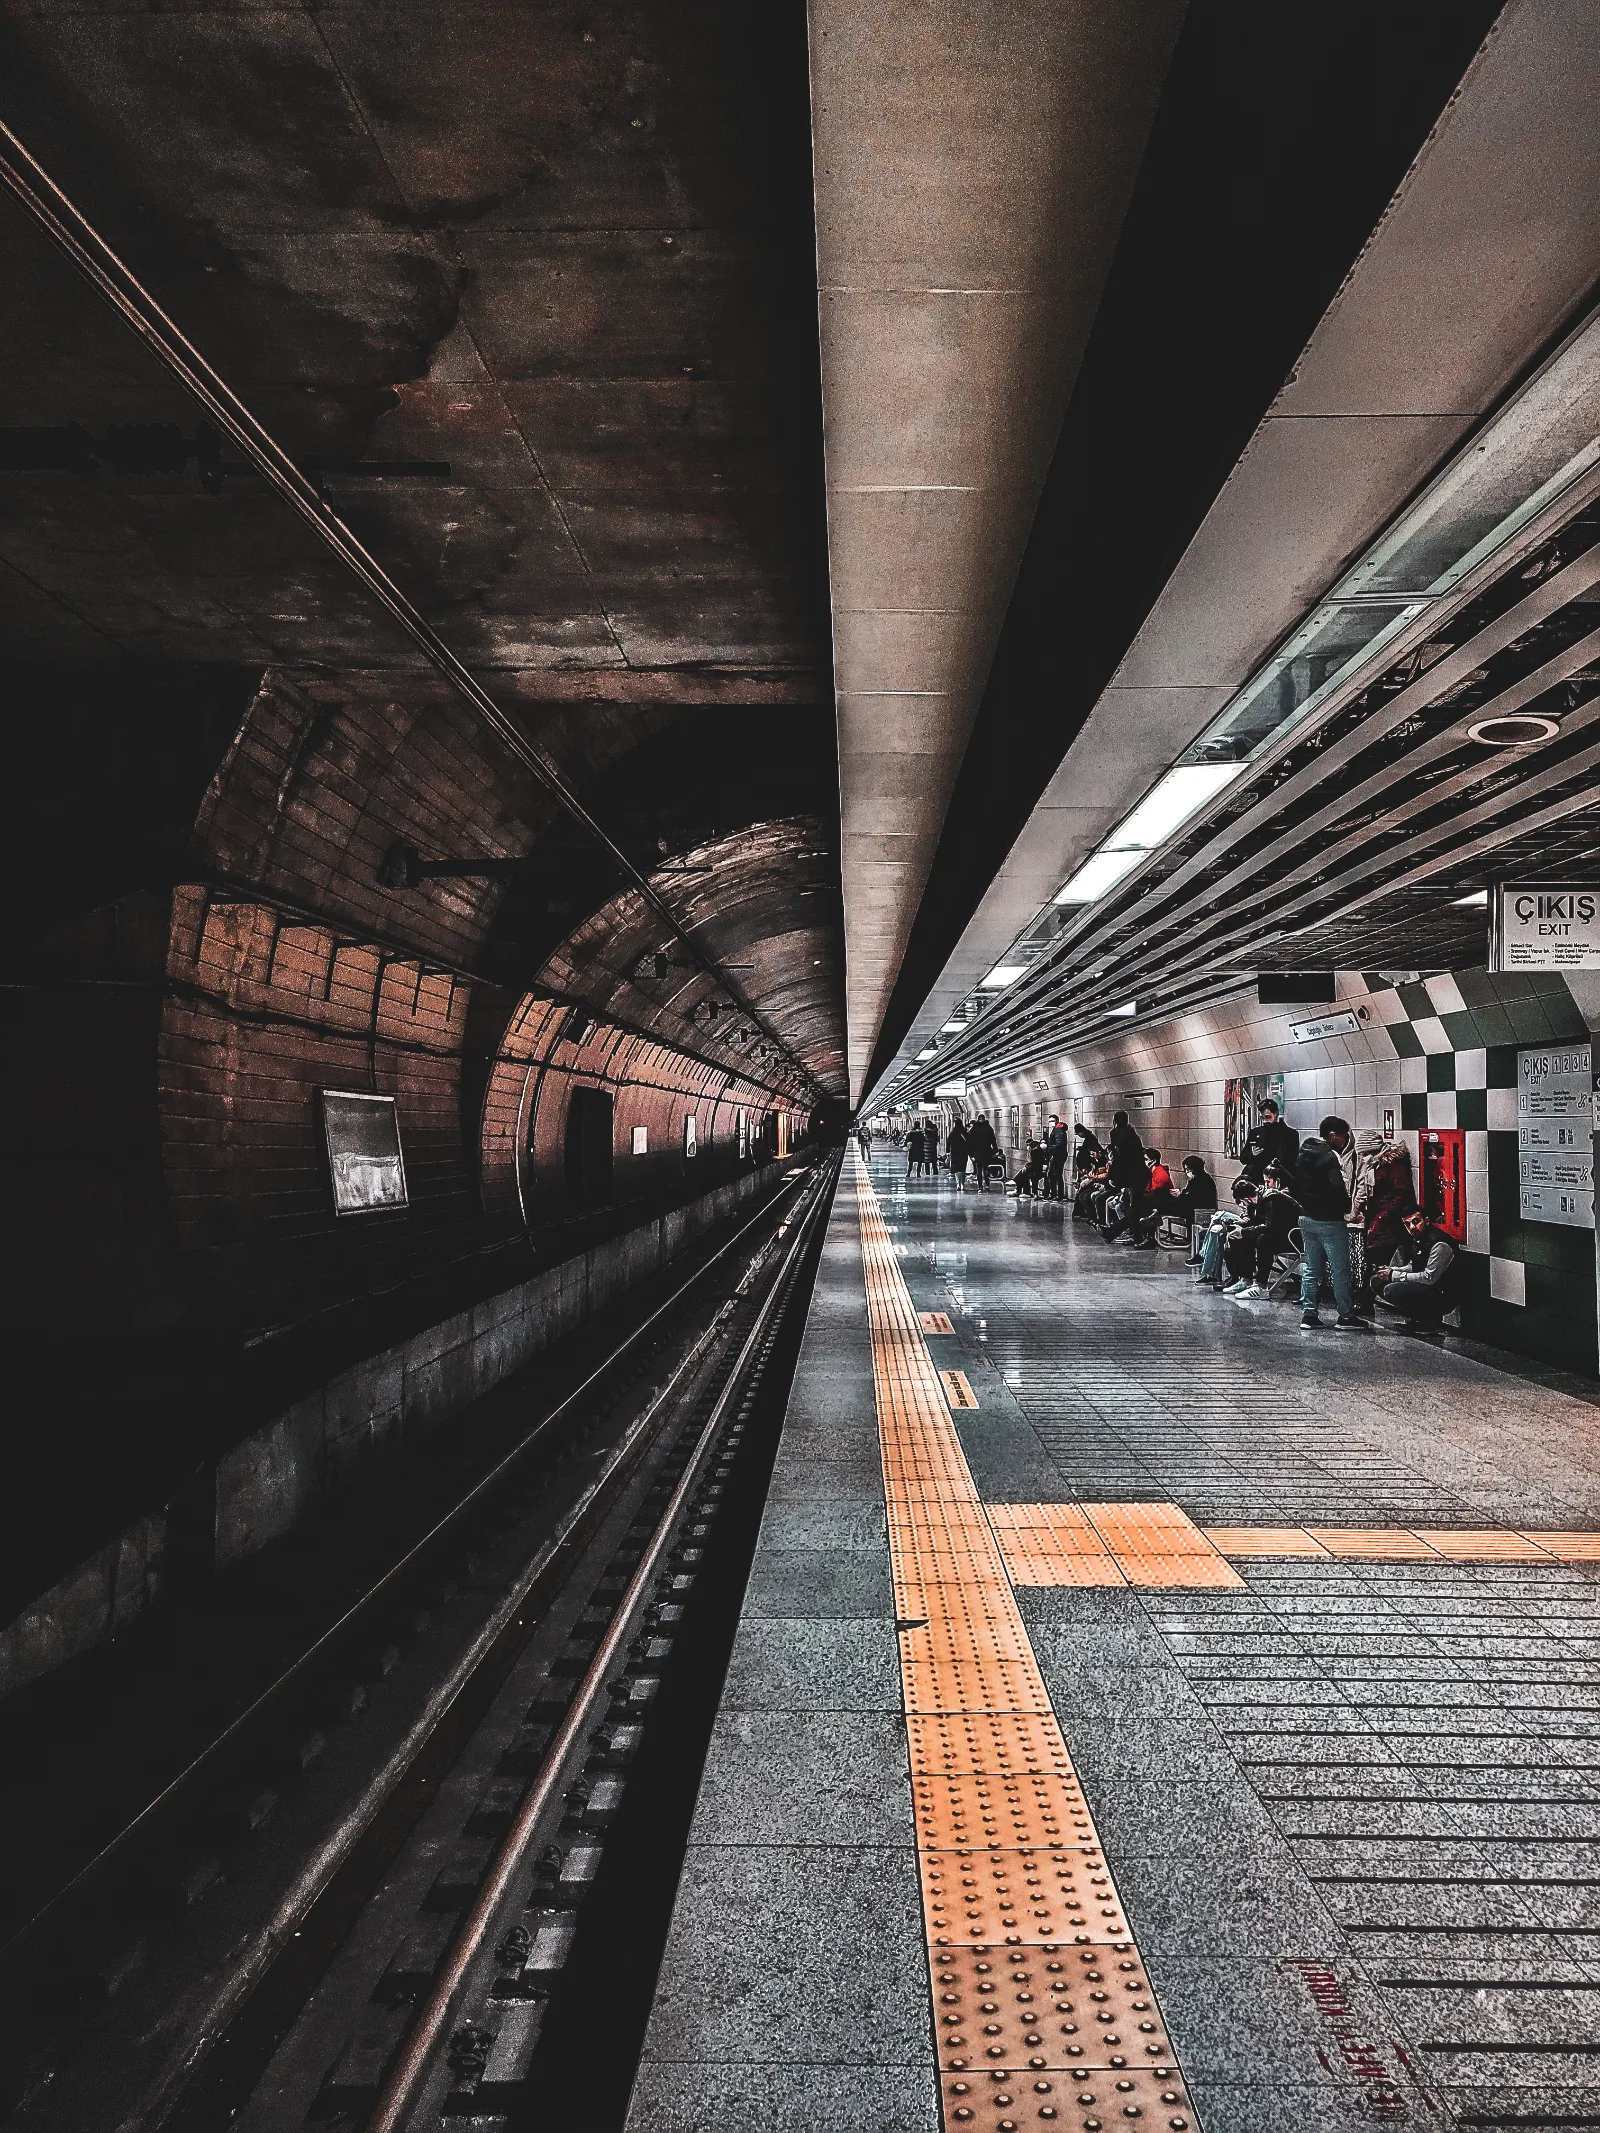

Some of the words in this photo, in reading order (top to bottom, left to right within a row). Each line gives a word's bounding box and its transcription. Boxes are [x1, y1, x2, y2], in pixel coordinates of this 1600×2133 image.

[1514, 895, 1596, 925] ÇIKIŞ
[1538, 923, 1572, 936] EXIT
[1523, 1056, 1549, 1080] ÇIKIŞ
